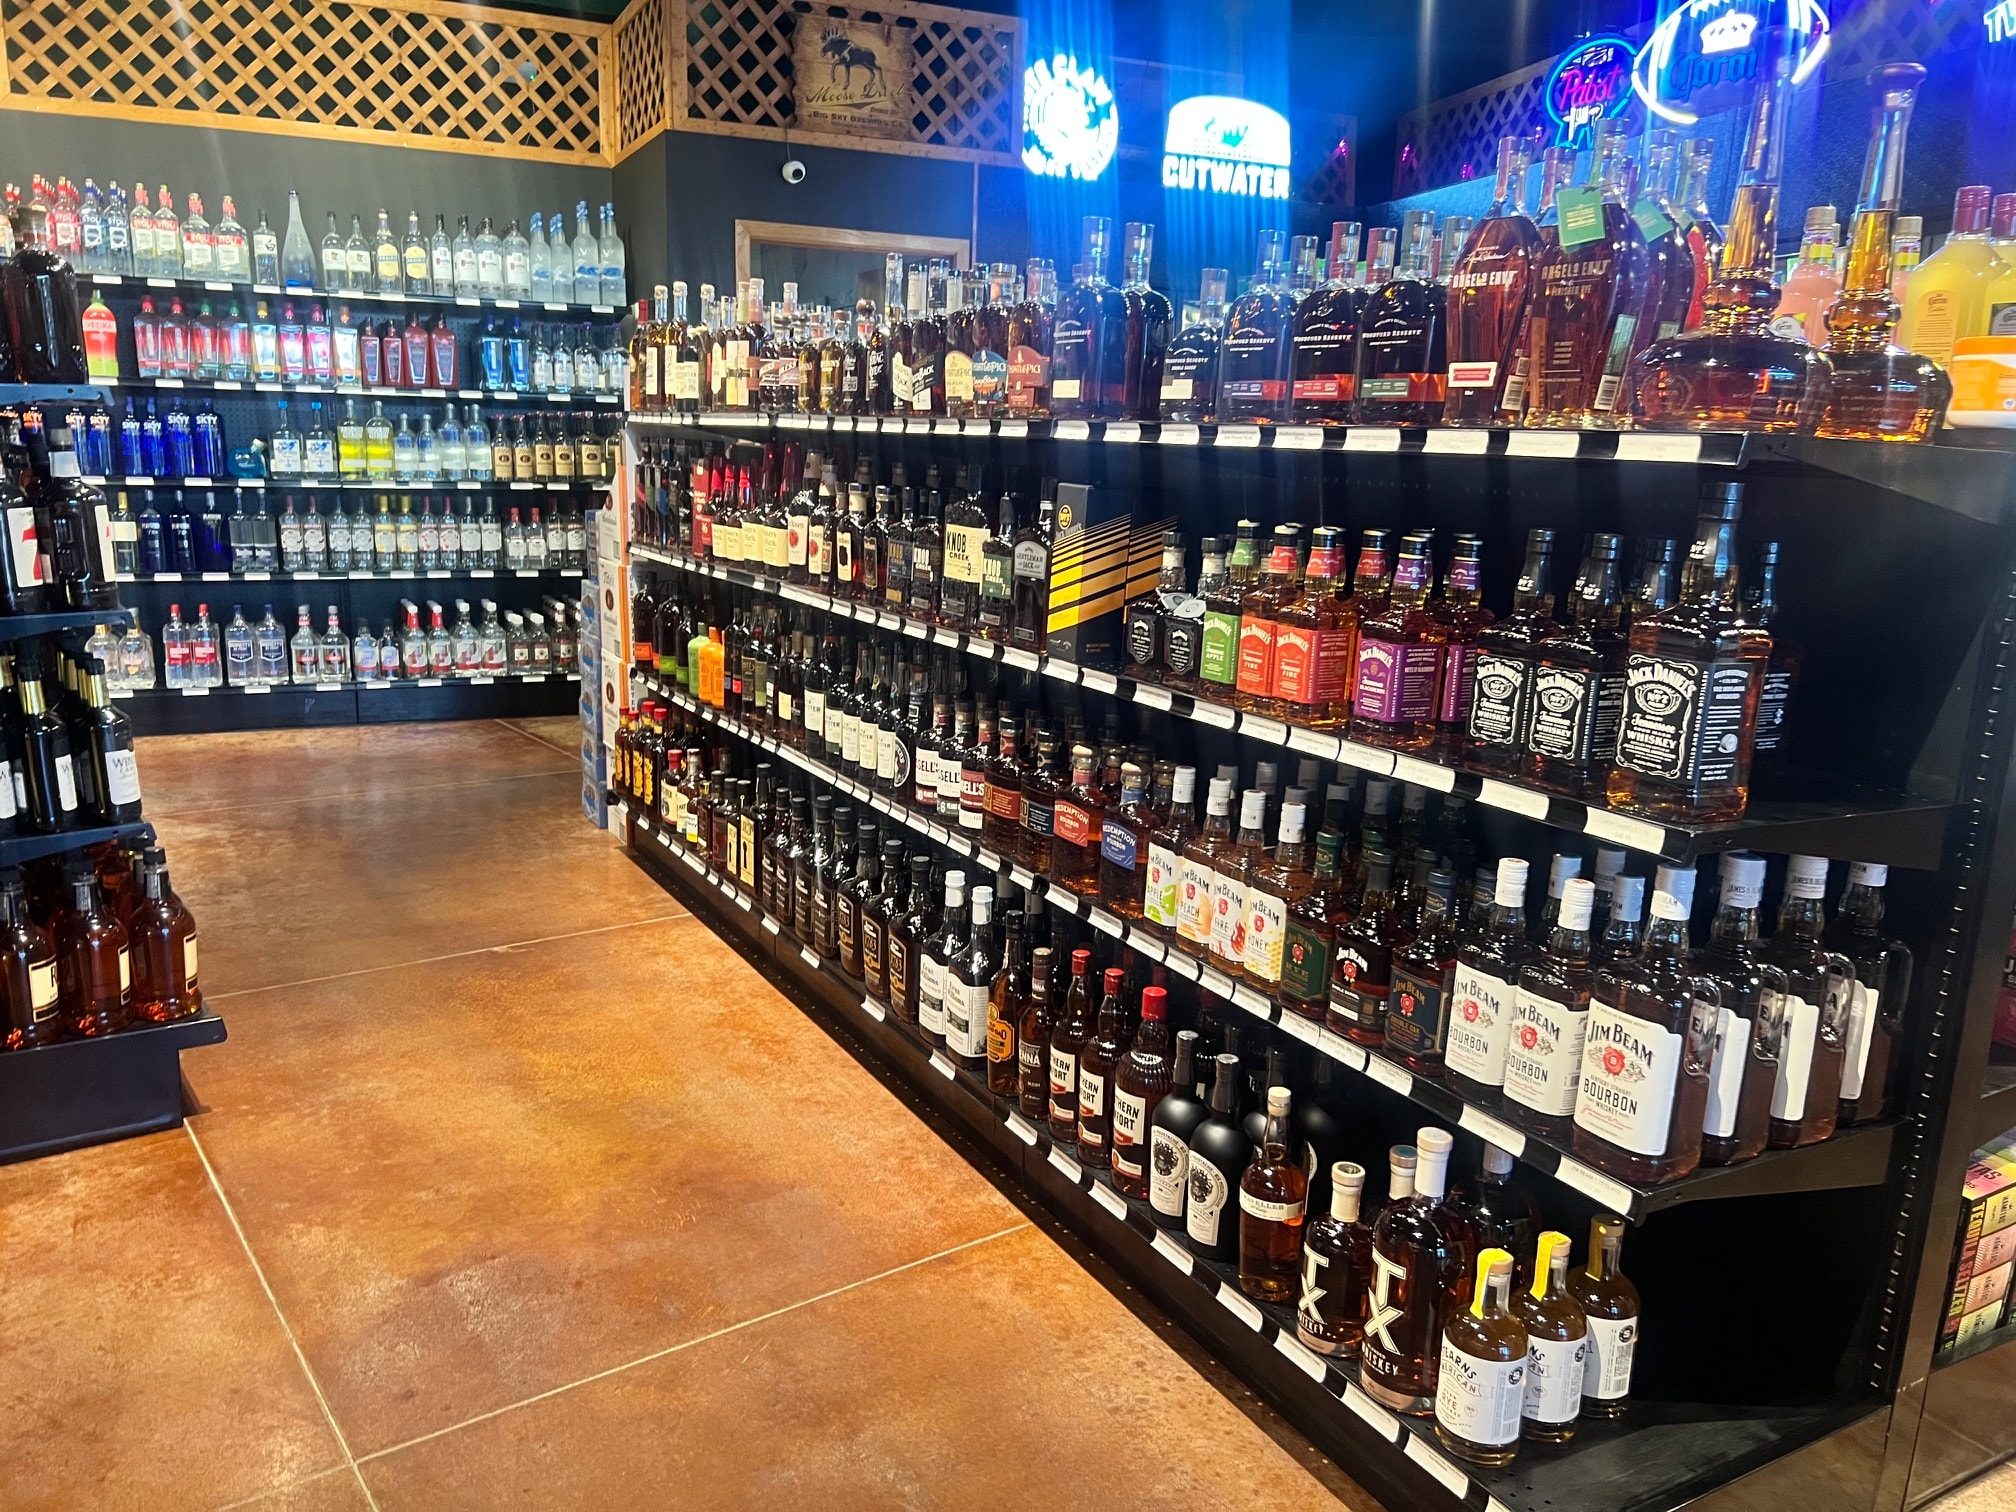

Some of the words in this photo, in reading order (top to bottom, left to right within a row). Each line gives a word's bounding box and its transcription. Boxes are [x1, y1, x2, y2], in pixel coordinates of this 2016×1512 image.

[806, 86, 855, 103] Moose
[1560, 63, 1624, 111] Pabst
[813, 111, 828, 119] BIG
[831, 113, 847, 122] SKY
[1163, 155, 1290, 199] CUTWATER
[1323, 334, 1352, 342] RESERVE
[1362, 331, 1391, 339] WOODFORD
[1392, 329, 1422, 337] RESERVE
[947, 531, 966, 552] KNOB
[913, 547, 930, 565] KNOB
[949, 551, 970, 561] CREEK
[1016, 552, 1044, 563] GENTLEMAN
[967, 563, 972, 576] 9
[984, 557, 1002, 577] KNOB
[1022, 560, 1035, 570] JACK
[985, 574, 1004, 585] CREEK
[1001, 585, 1006, 596] 7
[1289, 632, 1309, 652] DANIEL'S
[1205, 652, 1224, 662] APPLE
[1244, 662, 1258, 670] FIRE
[1282, 670, 1298, 678] FIRE
[1477, 664, 1495, 680] JACK
[1494, 662, 1524, 687] DANIEL'S
[1536, 677, 1555, 691] JACK
[1554, 673, 1585, 700] DANIEL'S
[1627, 665, 1655, 687] JACK
[1654, 663, 1698, 699] DANIEL'S
[1477, 709, 1511, 723] WHISKEY
[1631, 713, 1676, 735] Tennessee
[1536, 723, 1572, 738] WHISKEY
[1627, 730, 1677, 749] WHISKEY
[941, 801, 946, 813] 6
[1060, 816, 1079, 828] BOURBON
[1107, 836, 1126, 850] BOURBON
[1156, 853, 1172, 877] BEAM
[1189, 867, 1210, 894] BEAM
[1727, 885, 1746, 893] JAMES
[1790, 876, 1809, 885] JAMES
[1222, 882, 1243, 910] BEAM
[1180, 900, 1200, 917] PEACH
[1259, 900, 1280, 927] BEAM
[1214, 916, 1229, 933] FIRE
[1248, 933, 1268, 952] HONEY
[1336, 947, 1350, 961] JIM
[1349, 949, 1368, 973] BEAM
[1286, 962, 1309, 979] RYE
[1393, 980, 1406, 993] JIM
[1406, 981, 1425, 1006] BEAM
[1470, 980, 1500, 1016] BEAM
[1528, 1005, 1561, 1043] BEAM
[1587, 1020, 1610, 1043] JIM
[1613, 1023, 1654, 1069] BEAM
[1583, 1078, 1638, 1116] BOURBON
[1610, 1082, 1632, 1098] STRAIGHT
[1596, 1100, 1618, 1117] WHISKEY
[1441, 1392, 1458, 1411] RYE
